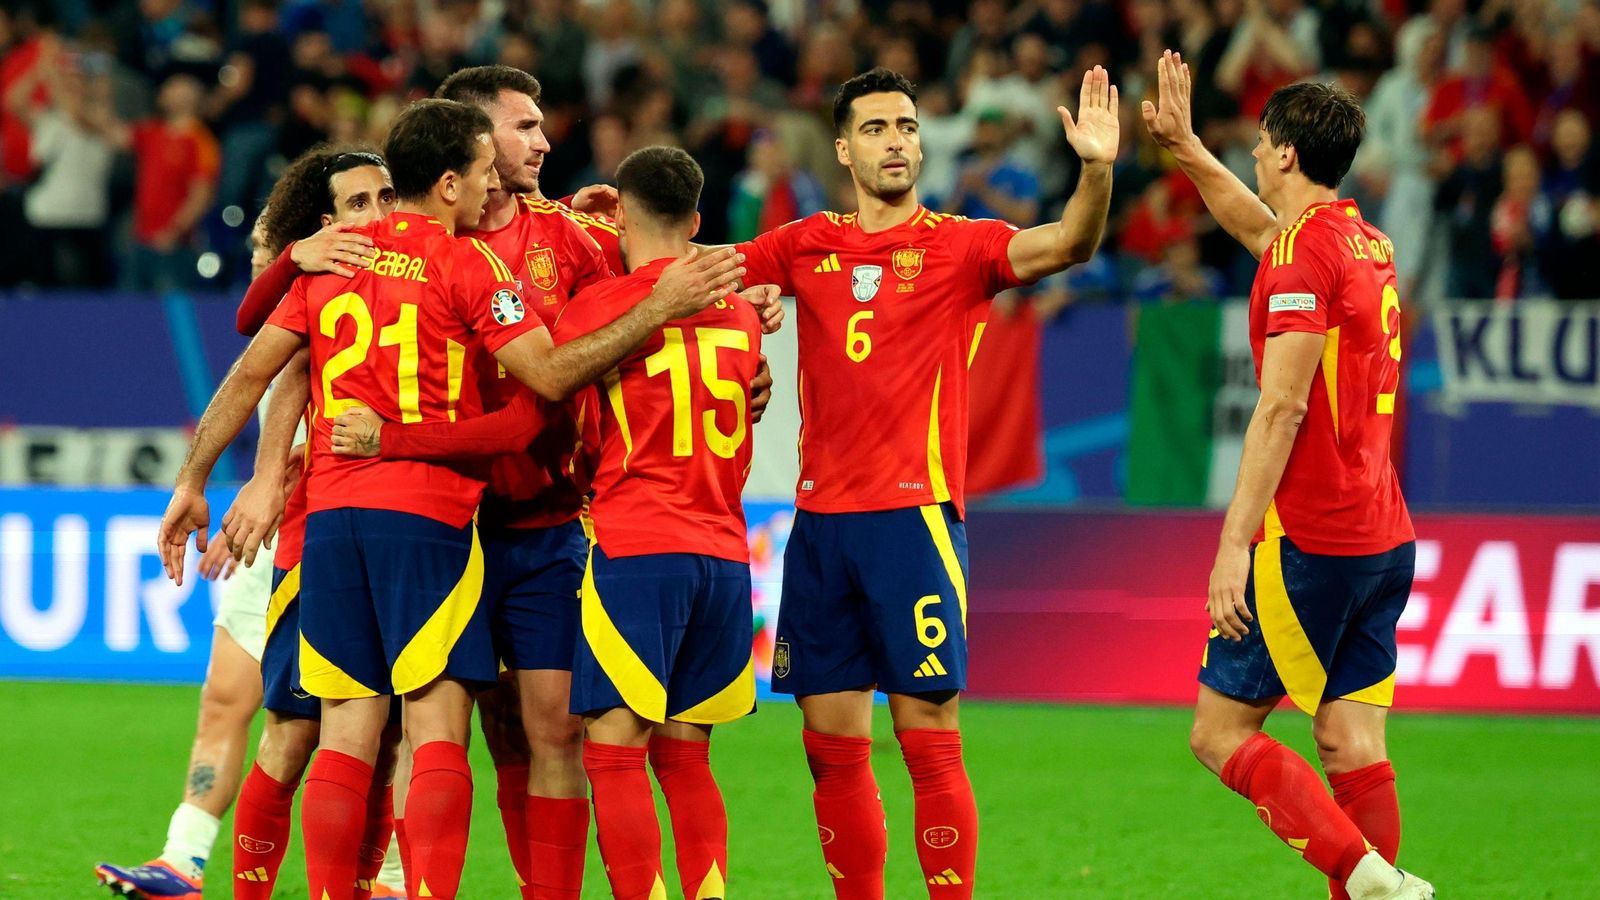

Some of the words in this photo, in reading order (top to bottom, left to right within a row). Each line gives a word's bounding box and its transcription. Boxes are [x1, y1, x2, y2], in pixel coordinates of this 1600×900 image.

[1346, 234, 1368, 259] LE
[320, 291, 423, 424] 21
[846, 310, 874, 363] 6
[645, 327, 750, 459] 15
[0, 513, 238, 653] UR
[914, 594, 947, 648] 6
